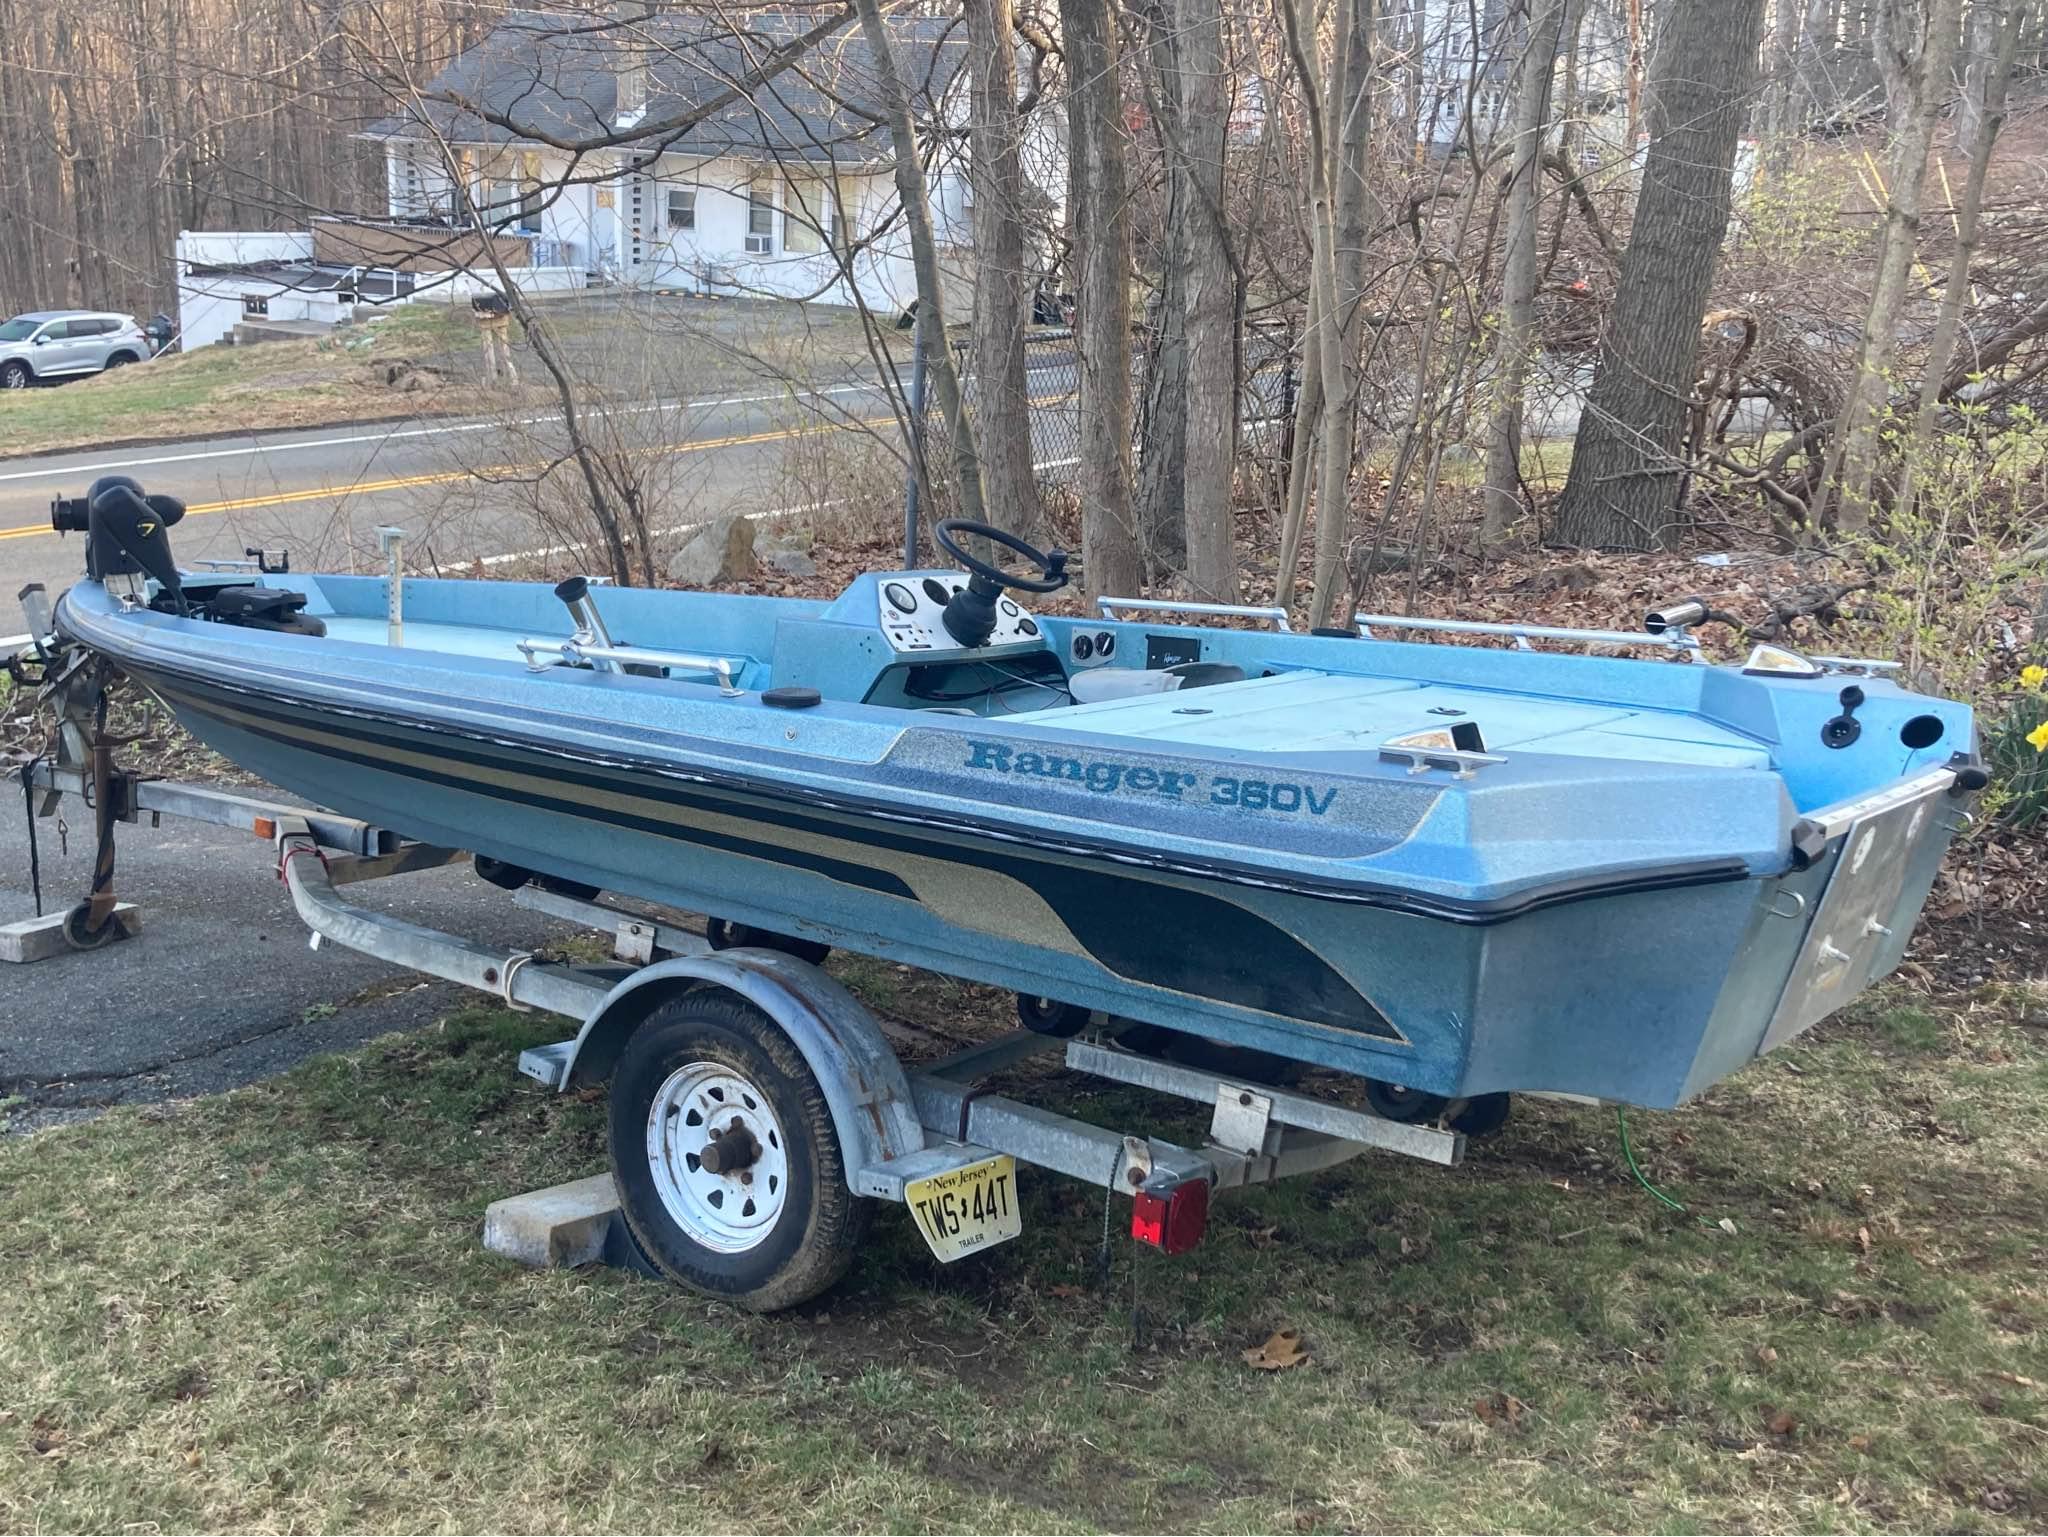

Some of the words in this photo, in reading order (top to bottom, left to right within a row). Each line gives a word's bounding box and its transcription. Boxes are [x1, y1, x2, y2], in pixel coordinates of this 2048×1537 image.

[965, 740, 1196, 794] Ranger
[1210, 776, 1337, 815] 360V
[933, 1177, 958, 1191] New
[958, 1167, 988, 1187] Jersey
[958, 1233, 984, 1249] TRAILER
